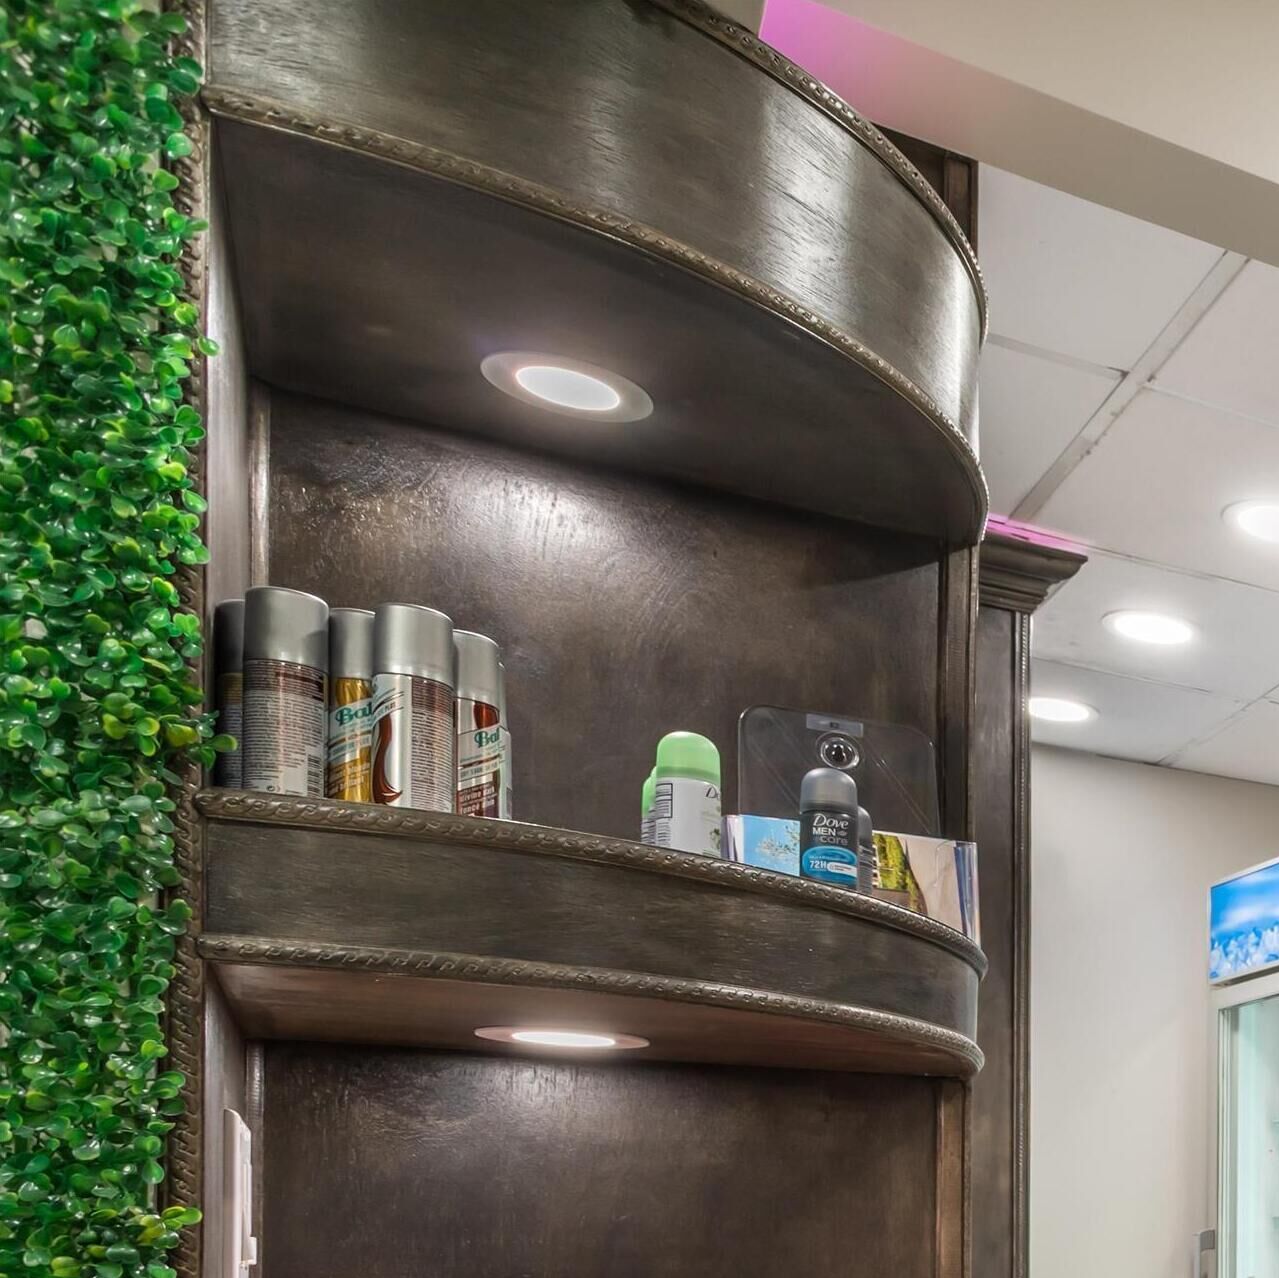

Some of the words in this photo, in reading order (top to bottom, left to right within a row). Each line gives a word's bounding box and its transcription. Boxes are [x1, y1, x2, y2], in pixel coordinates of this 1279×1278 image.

[812, 813, 849, 828] Dove
[812, 827, 837, 836] MEN
[809, 860, 827, 870] 72H
